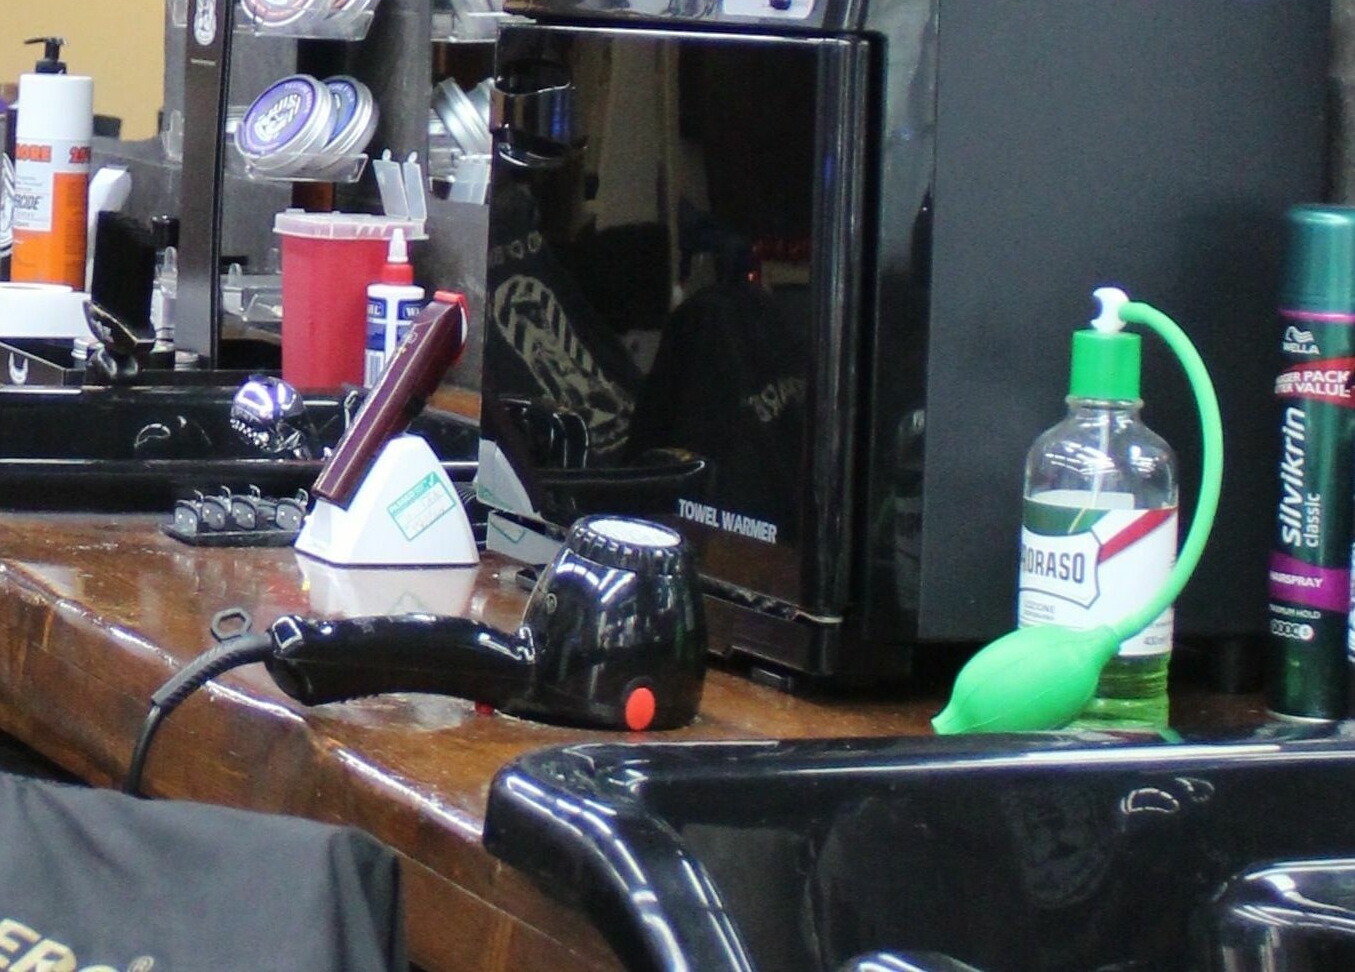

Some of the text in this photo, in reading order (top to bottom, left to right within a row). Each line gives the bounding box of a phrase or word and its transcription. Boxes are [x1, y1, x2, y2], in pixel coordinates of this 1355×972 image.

[1303, 370, 1351, 383] PACK
[678, 498, 777, 544] TOWEL WARMER
[1303, 492, 1321, 548] classic
